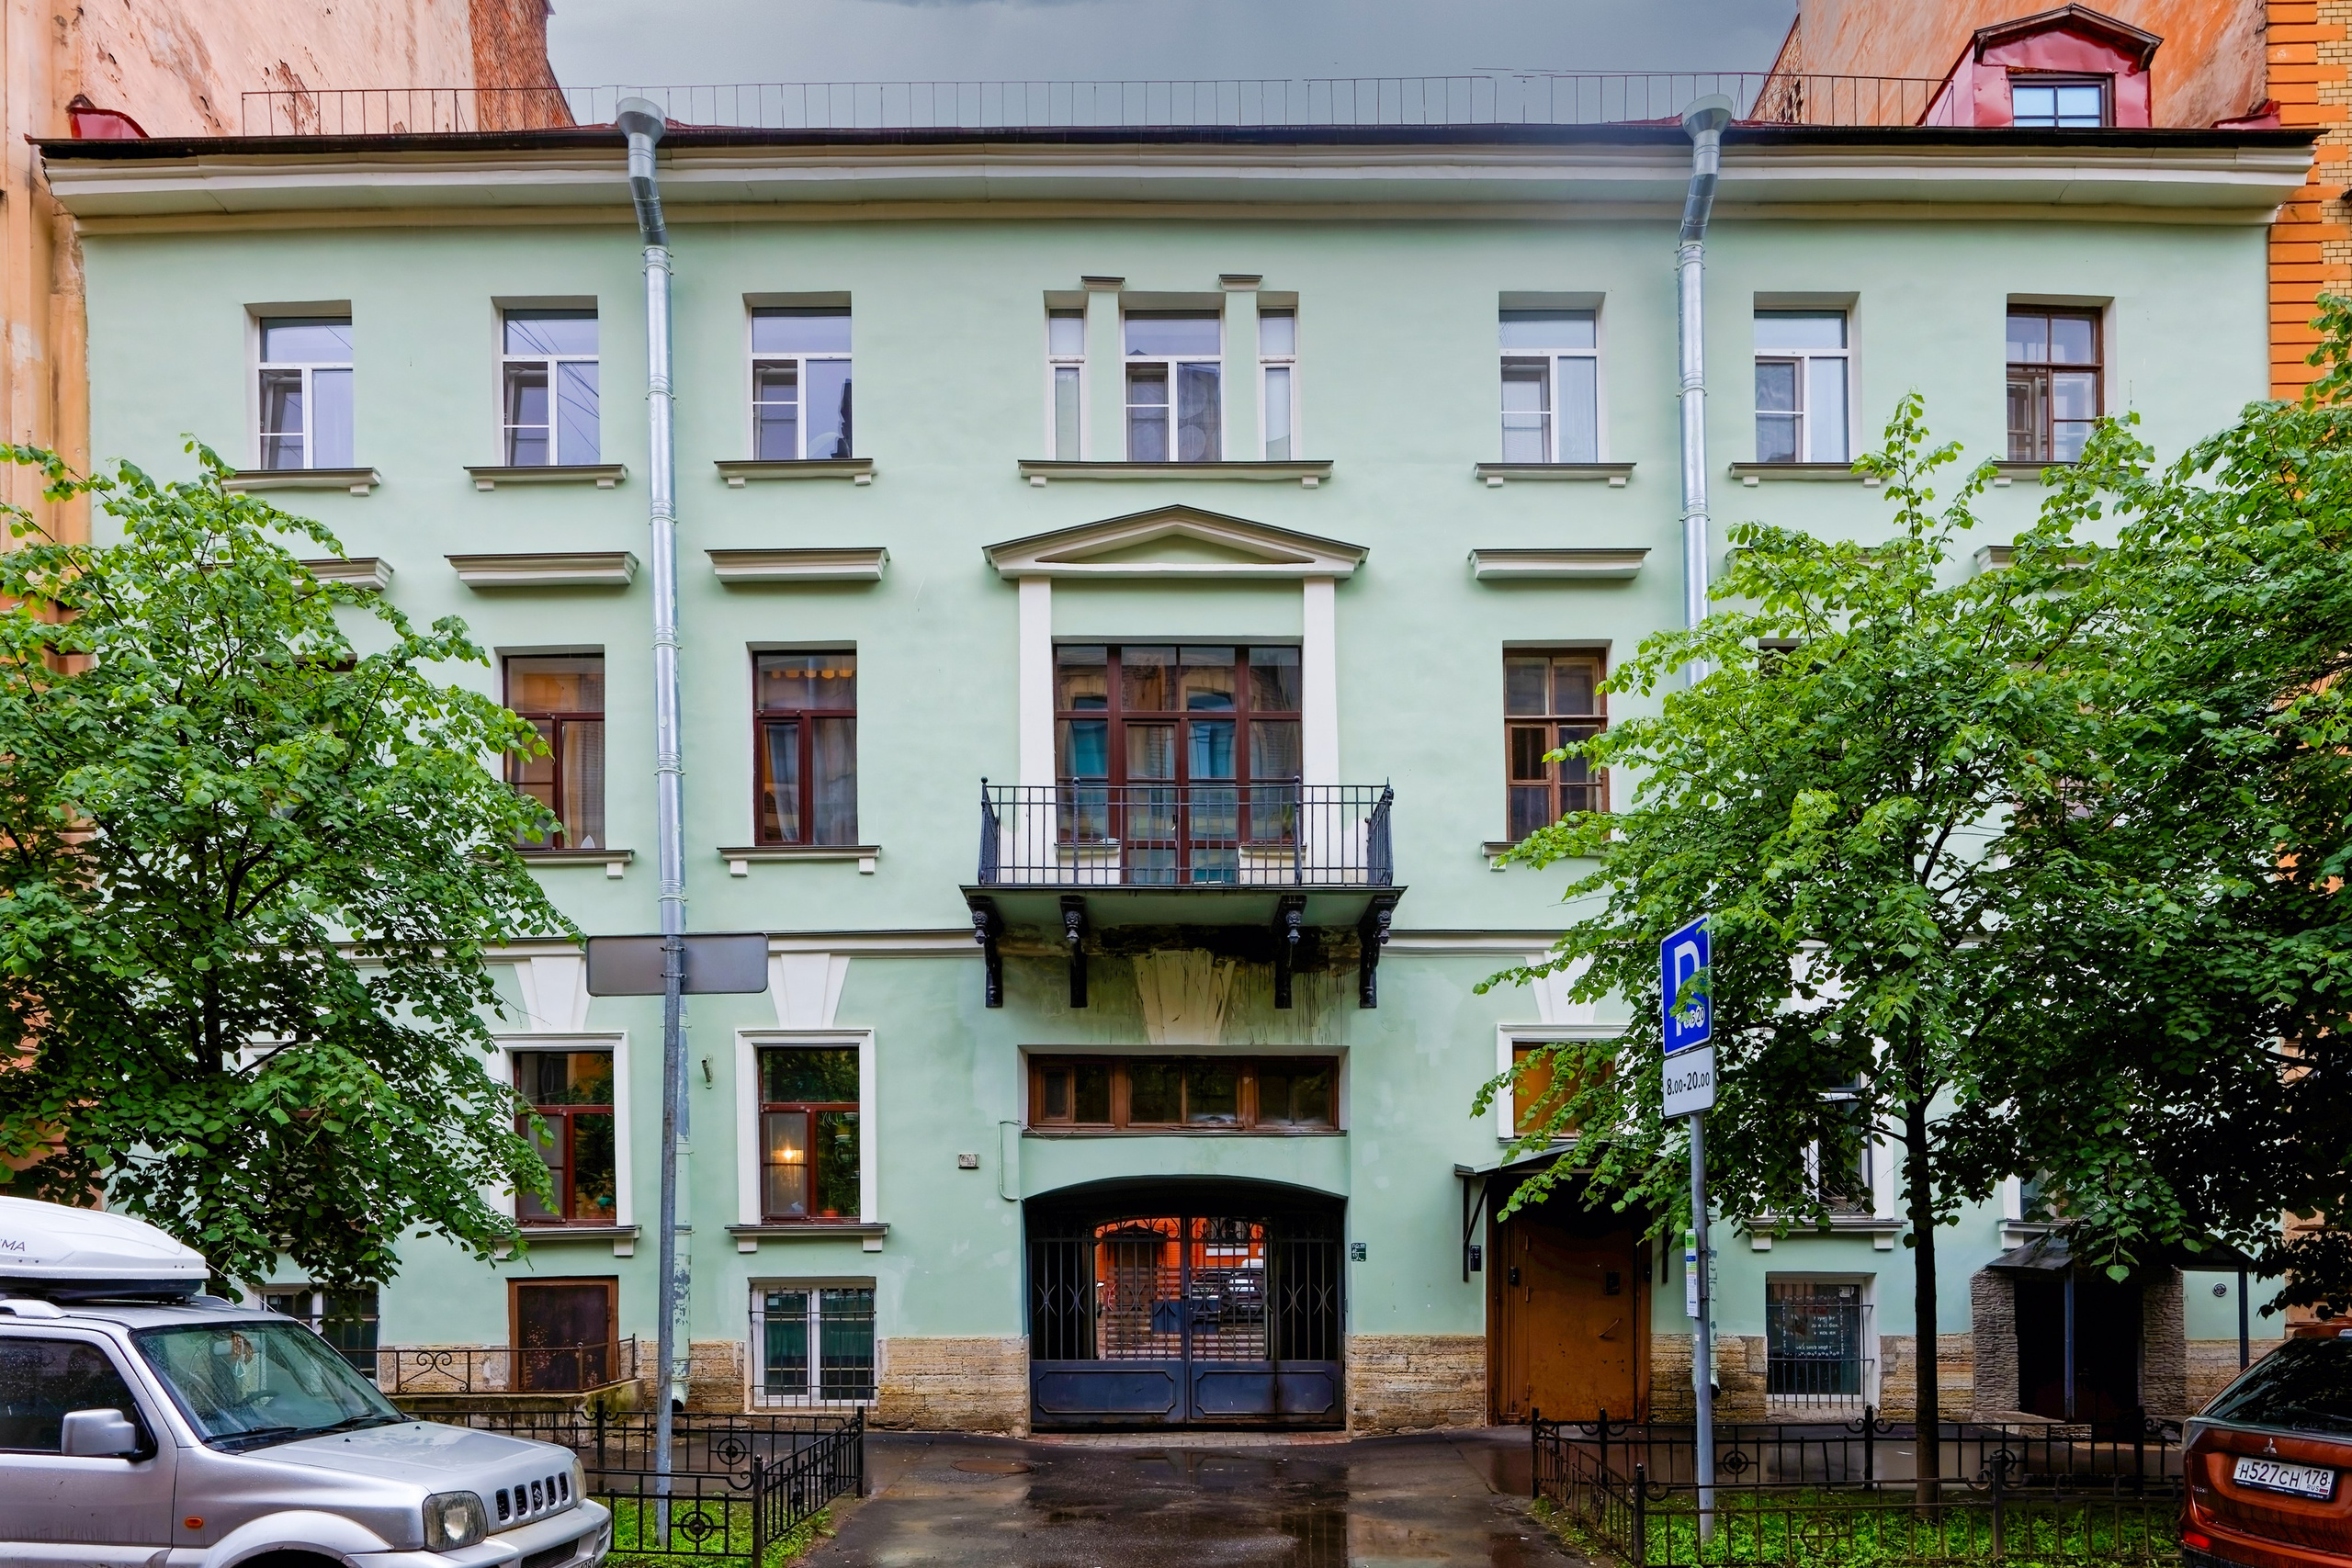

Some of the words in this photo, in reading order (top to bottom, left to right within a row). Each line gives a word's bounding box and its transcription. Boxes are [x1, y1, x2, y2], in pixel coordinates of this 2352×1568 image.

[1667, 1071, 1710, 1096] 8.00-20.00
[0, 1239, 25, 1252] MA
[2239, 1462, 2301, 1487] Н527СН
[2304, 1470, 2330, 1486] 178
